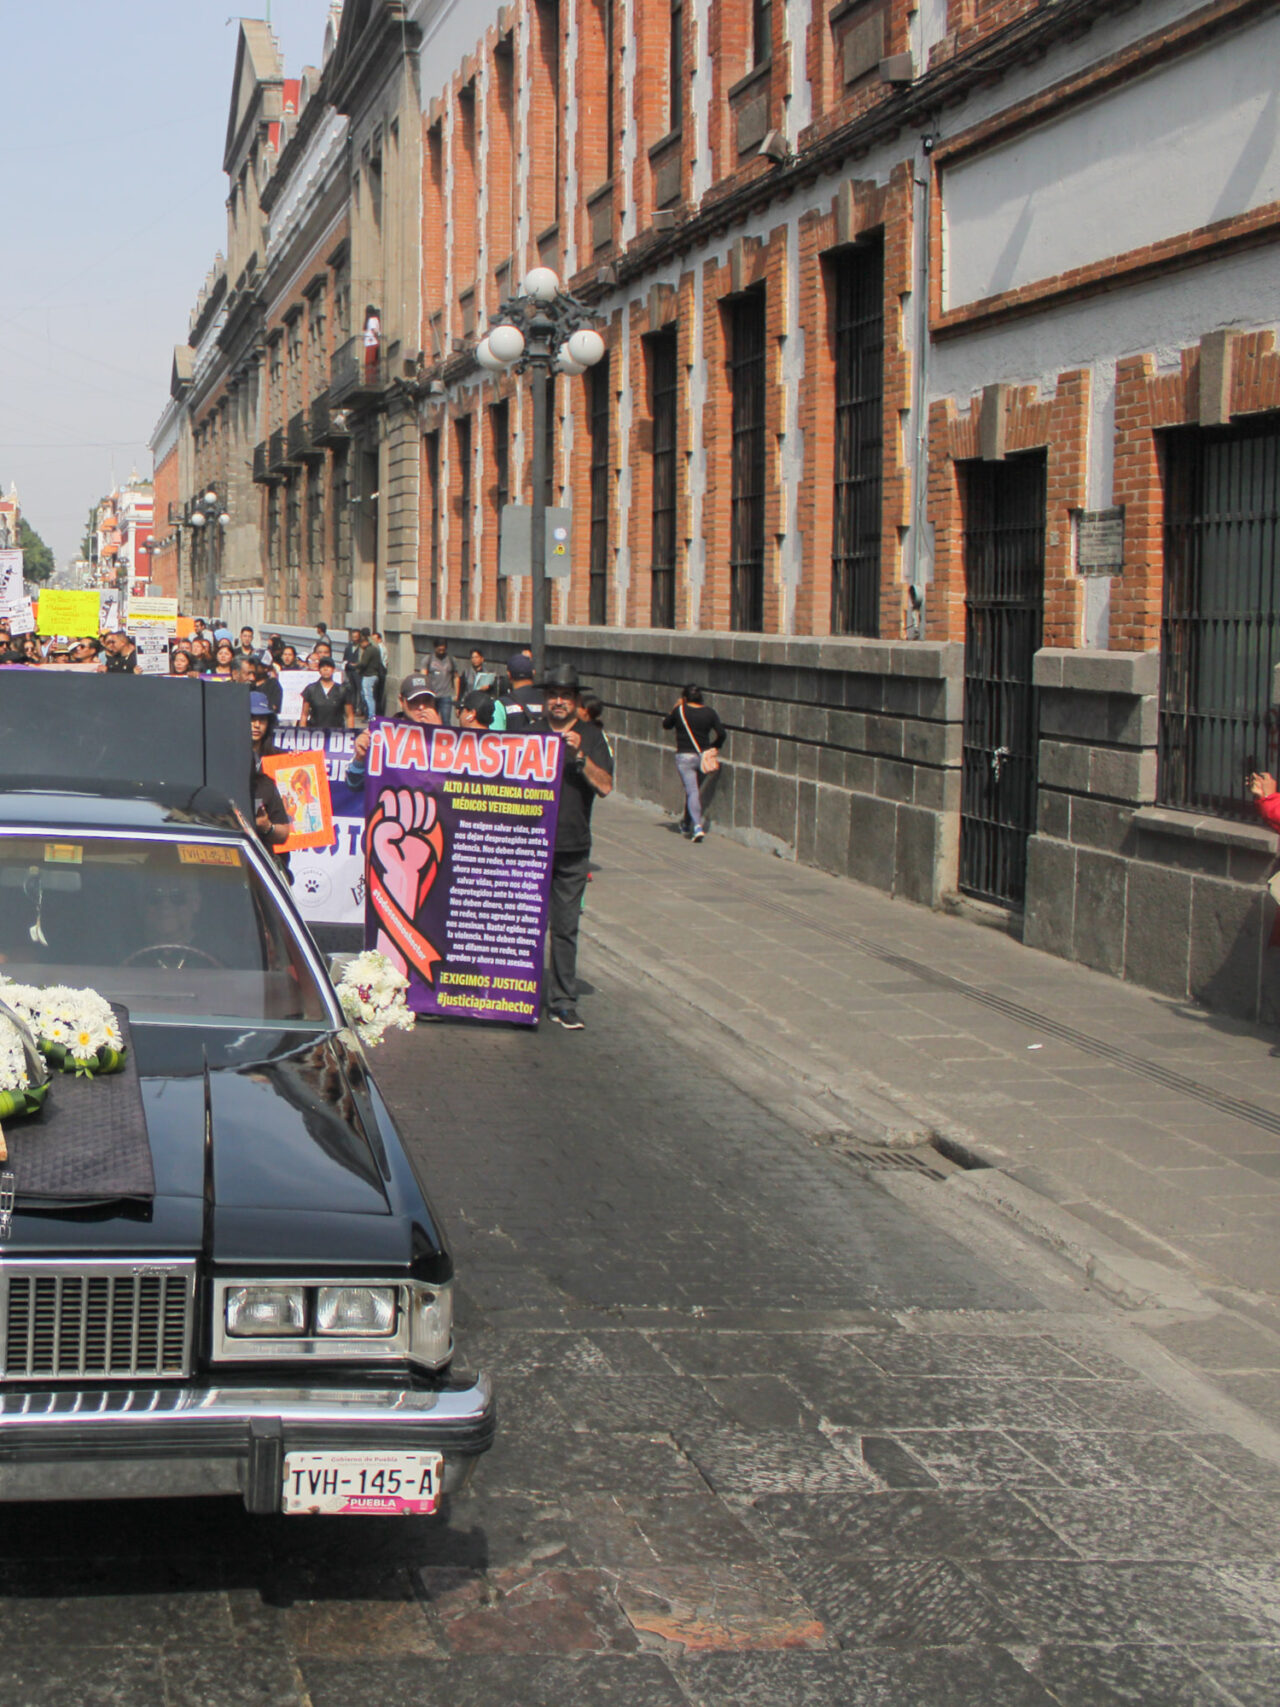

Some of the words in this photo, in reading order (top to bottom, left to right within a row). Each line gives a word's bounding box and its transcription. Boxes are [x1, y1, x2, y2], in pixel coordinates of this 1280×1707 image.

[329, 732, 355, 754] DE
[368, 721, 429, 776] ¡YA
[430, 728, 560, 782] BASTA!
[443, 781, 462, 793] ALTO
[464, 782, 470, 793] A
[471, 783, 481, 795] LA
[483, 784, 522, 799] VIOLENCIA
[524, 788, 554, 801] CONTRA
[488, 801, 543, 816] VETERINARIOS
[440, 972, 490, 987] ¡EXIGIMOS
[492, 977, 536, 993] JUSTICIA!
[437, 992, 534, 1014] #justiciaparahector
[292, 1469, 433, 1495] TVH-145-A
[350, 1498, 396, 1506] PUEBLA
